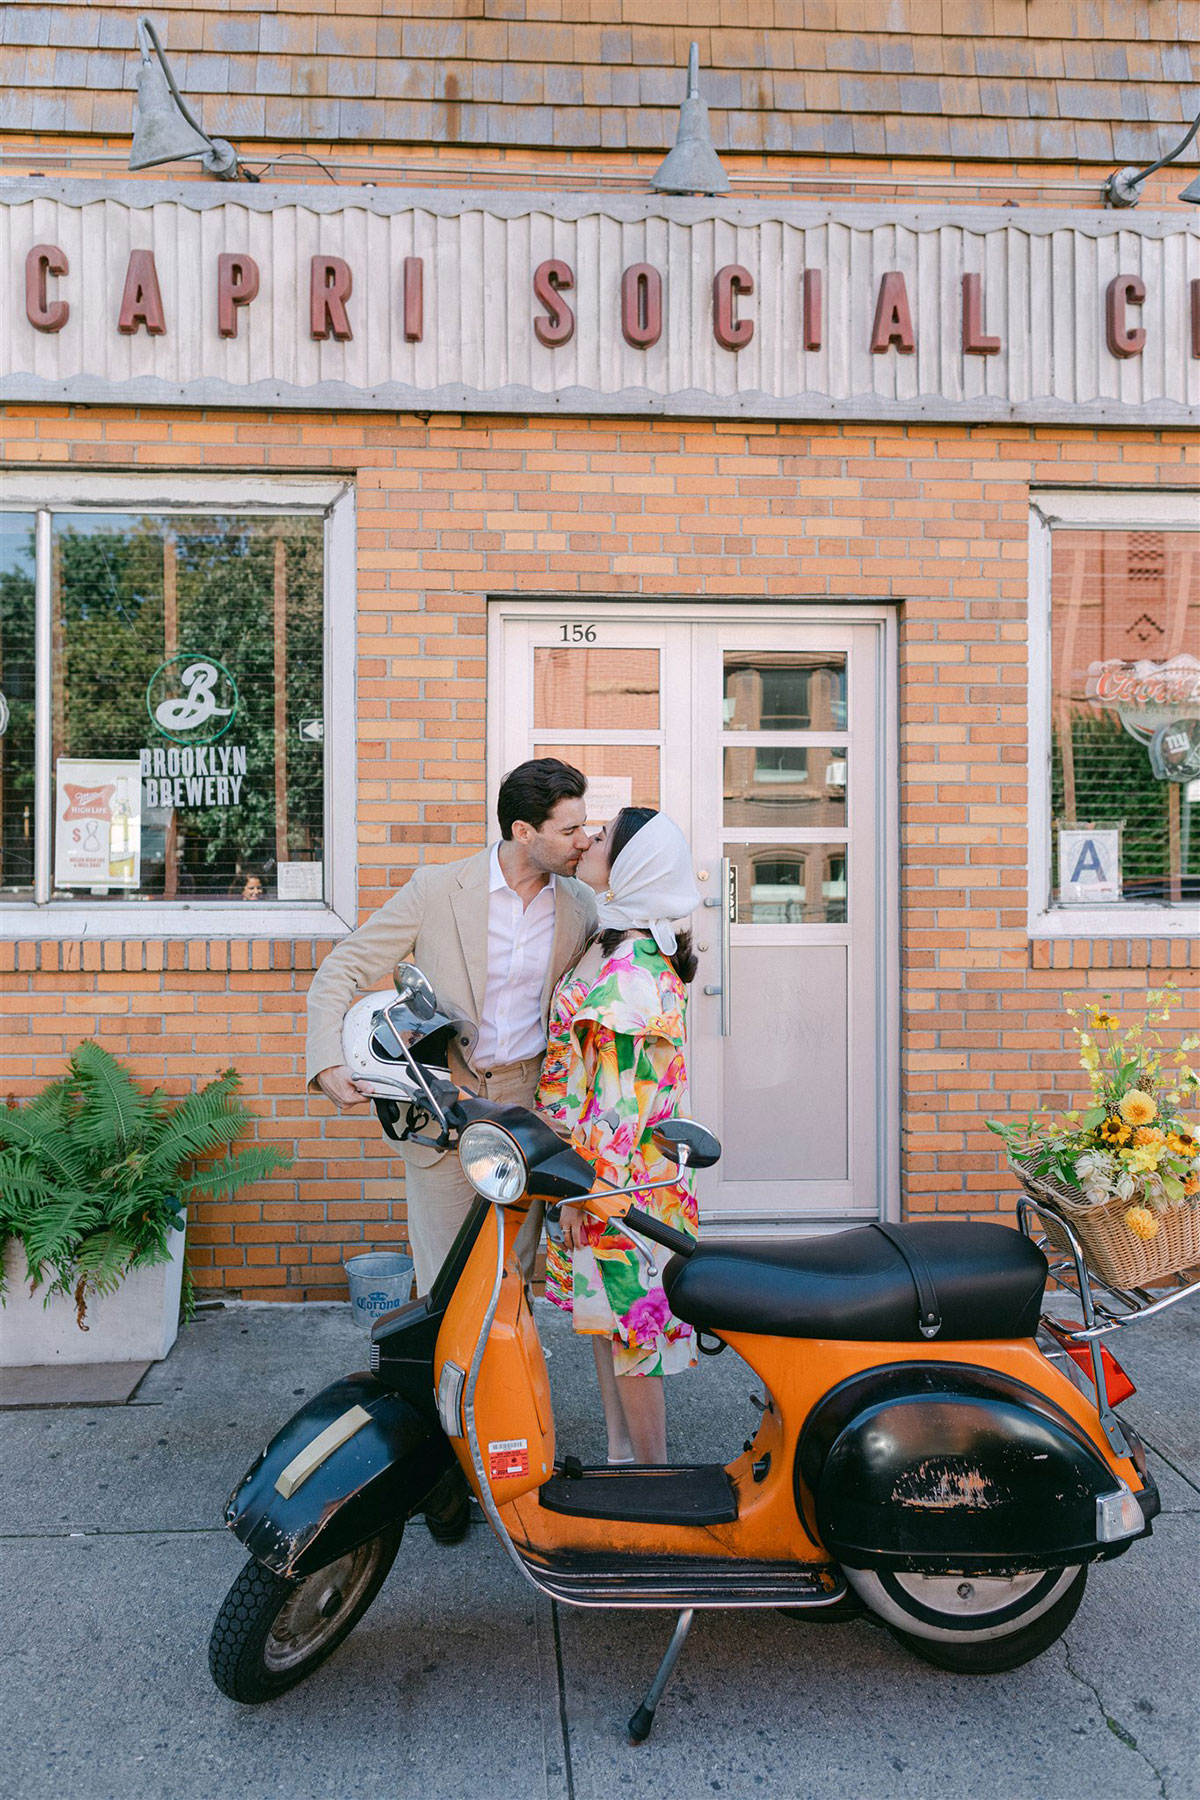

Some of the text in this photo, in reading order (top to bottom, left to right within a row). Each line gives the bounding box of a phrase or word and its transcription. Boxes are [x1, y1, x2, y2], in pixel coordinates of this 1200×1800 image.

[25, 244, 424, 343] CAPRI
[533, 258, 1001, 356] SOCIAL
[559, 623, 597, 642] 156
[156, 662, 232, 730] B
[1097, 666, 1184, 703] Coors
[139, 746, 247, 777] BROOKLYN
[75, 792, 104, 806] Miller
[146, 776, 243, 807] BREWERY
[71, 806, 108, 814] HIGH LIFE
[1070, 839, 1108, 883] A
[356, 1296, 400, 1310] Corona
